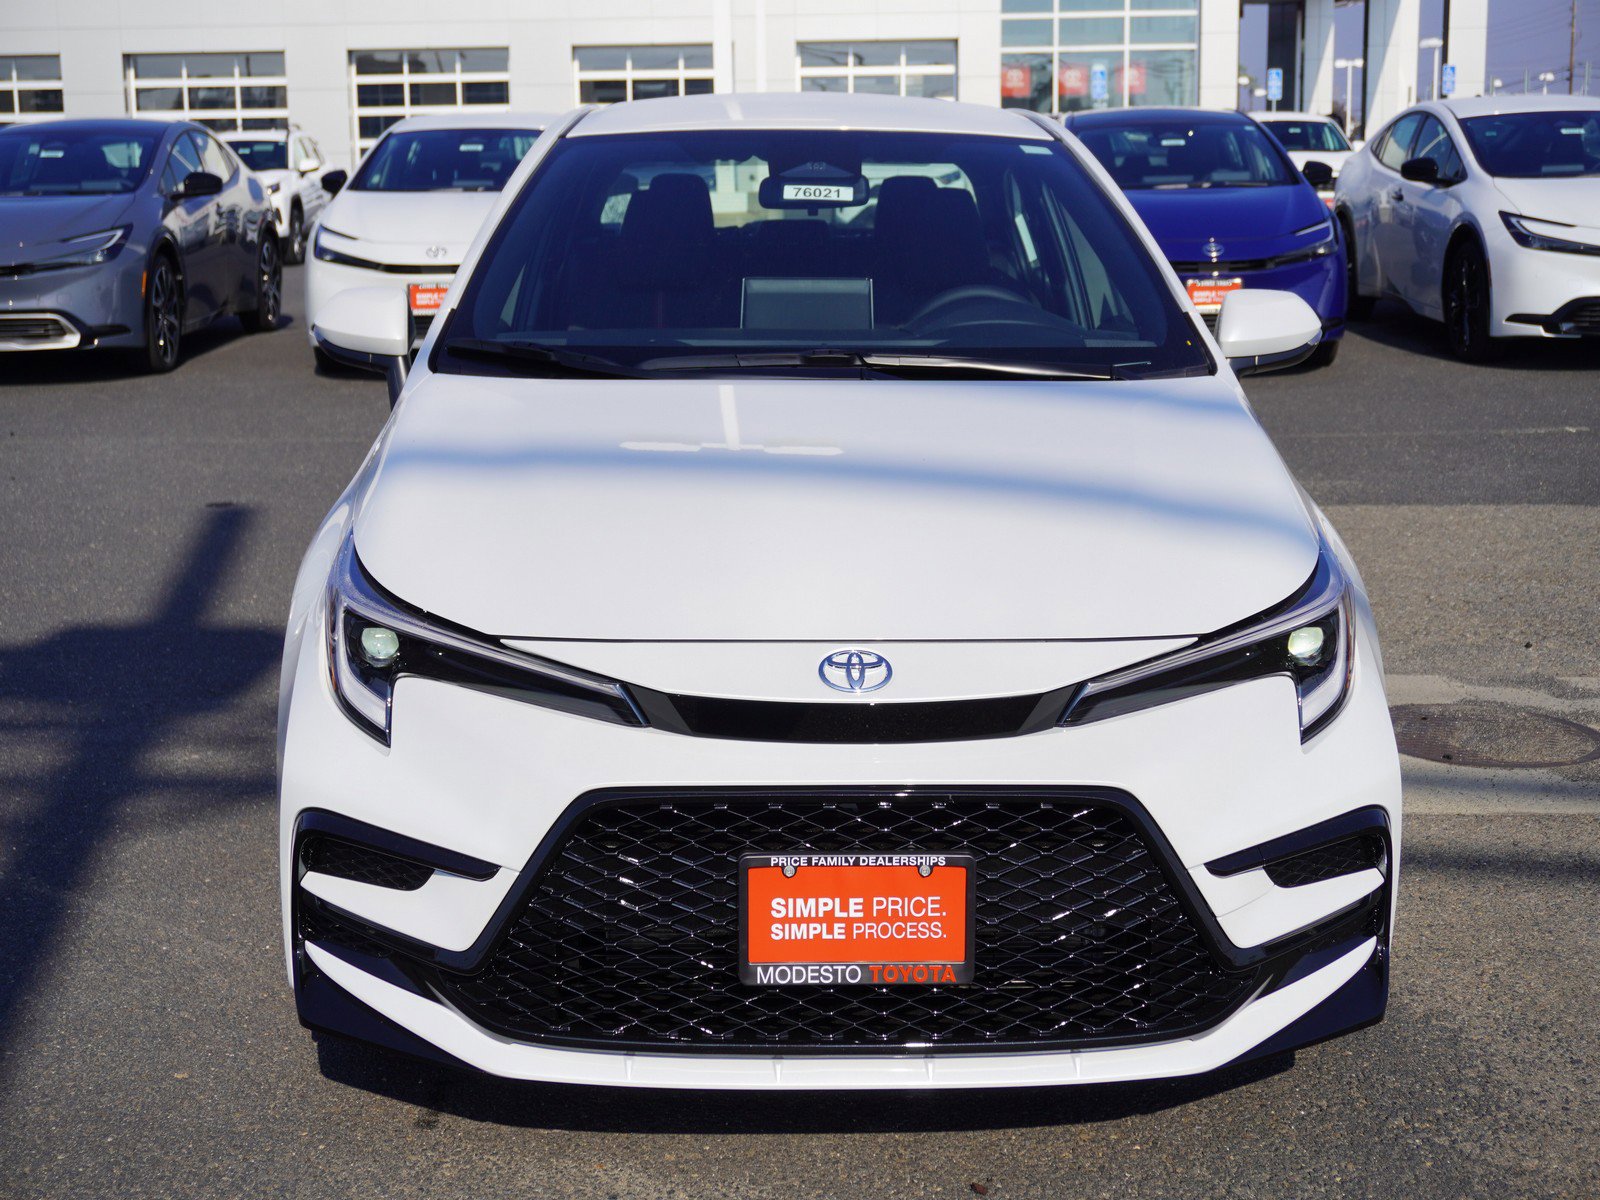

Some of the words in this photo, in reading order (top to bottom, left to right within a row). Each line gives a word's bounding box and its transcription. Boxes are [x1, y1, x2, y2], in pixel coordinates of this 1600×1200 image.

[793, 187, 840, 198] 76021
[770, 856, 808, 867] PRICE
[811, 856, 856, 866] FAMILY
[860, 856, 946, 866] DEALERSHIPS
[771, 897, 864, 918] SIMPLE
[873, 896, 947, 917] PRICE.
[771, 923, 846, 940] SIMPLE
[853, 921, 947, 939] PROCESS.
[757, 965, 861, 984] MODESTO
[869, 965, 957, 982] TOYOTA
